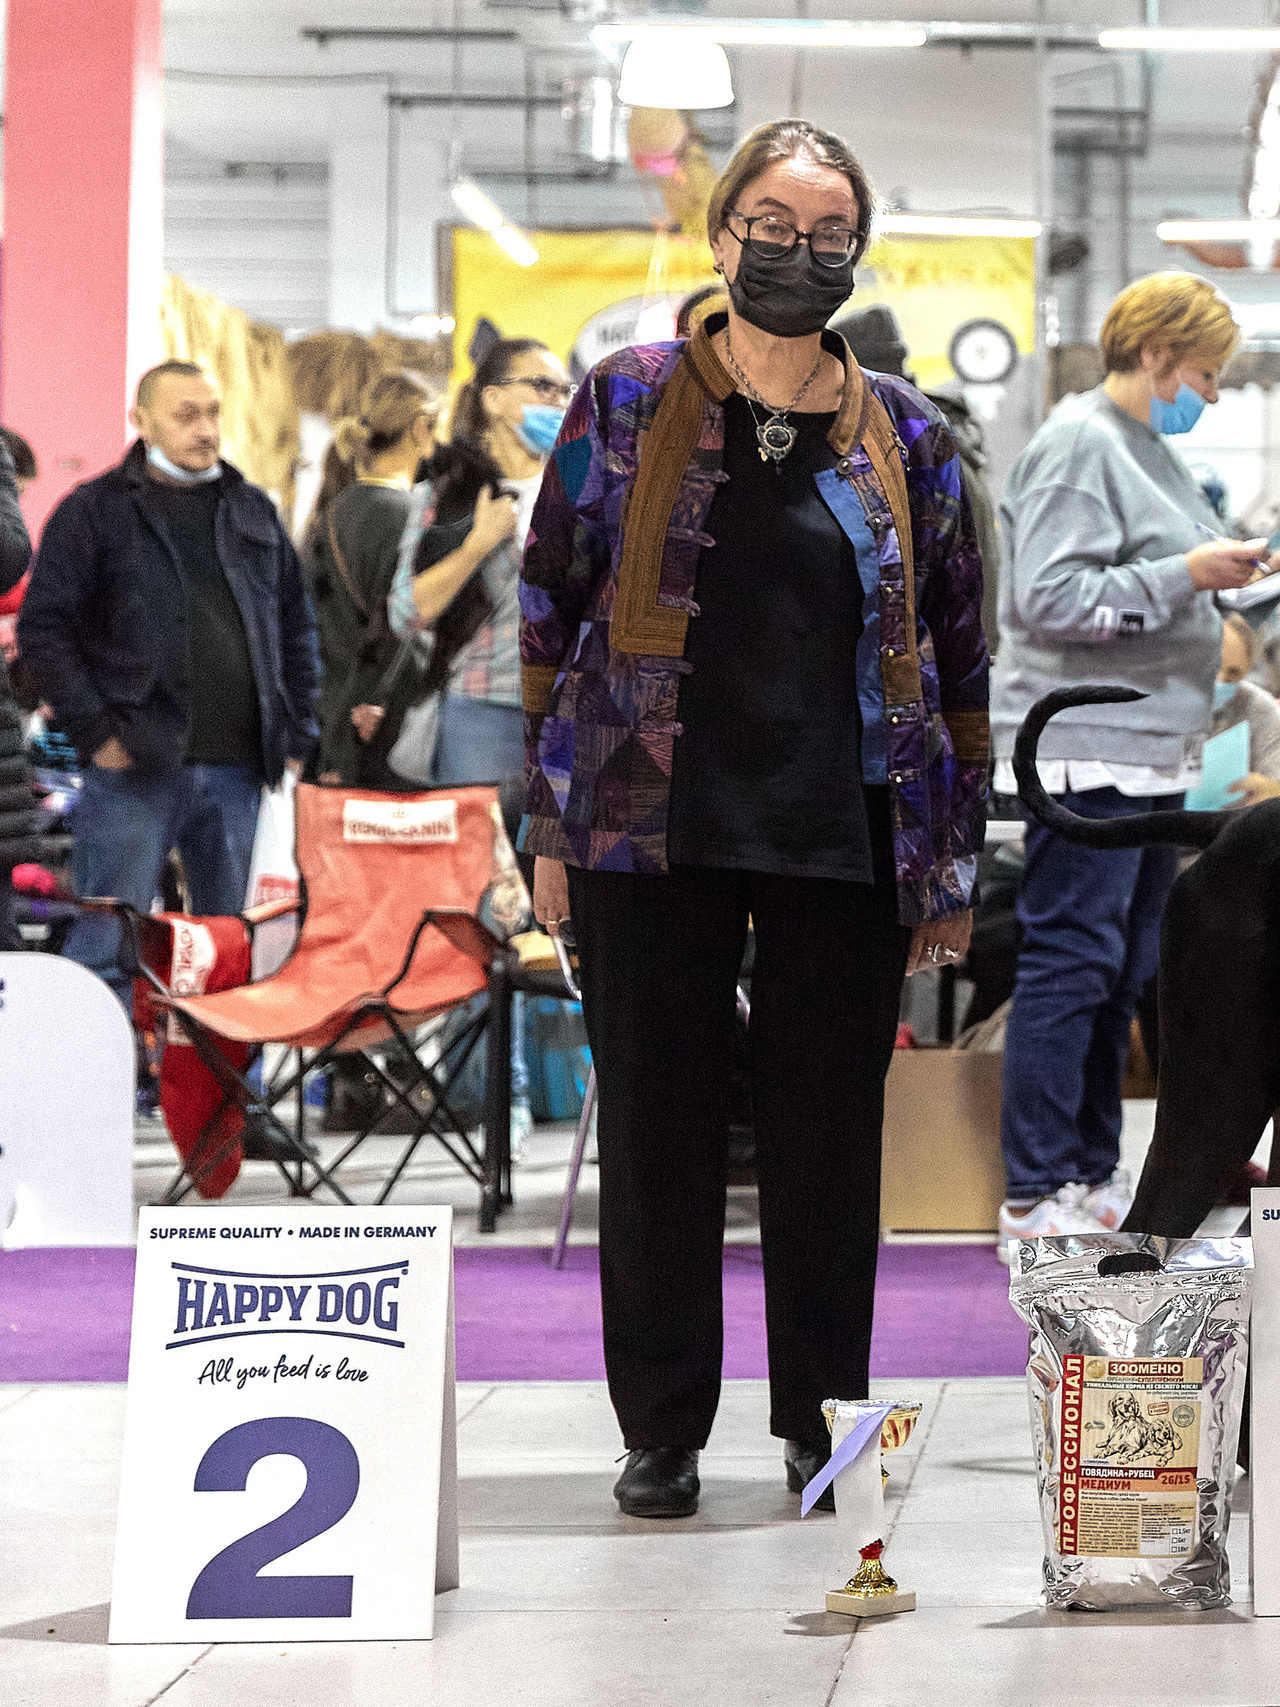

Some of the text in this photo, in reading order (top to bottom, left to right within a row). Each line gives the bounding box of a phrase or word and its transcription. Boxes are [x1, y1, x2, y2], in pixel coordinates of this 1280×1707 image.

[150, 1226, 437, 1239] SUPREME QUALITY MADE IN GERMANY
[173, 1276, 401, 1334] HAPPY DOG
[198, 1354, 370, 1390] All you feed is love
[1109, 1362, 1182, 1375] ЗООМЕНЮ
[1062, 1357, 1082, 1552] ПРОФЕССИОНАЛ
[1080, 1479, 1131, 1491] МЕДИУМ
[1161, 1474, 1191, 1485] 26/15
[185, 1416, 360, 1620] 2
